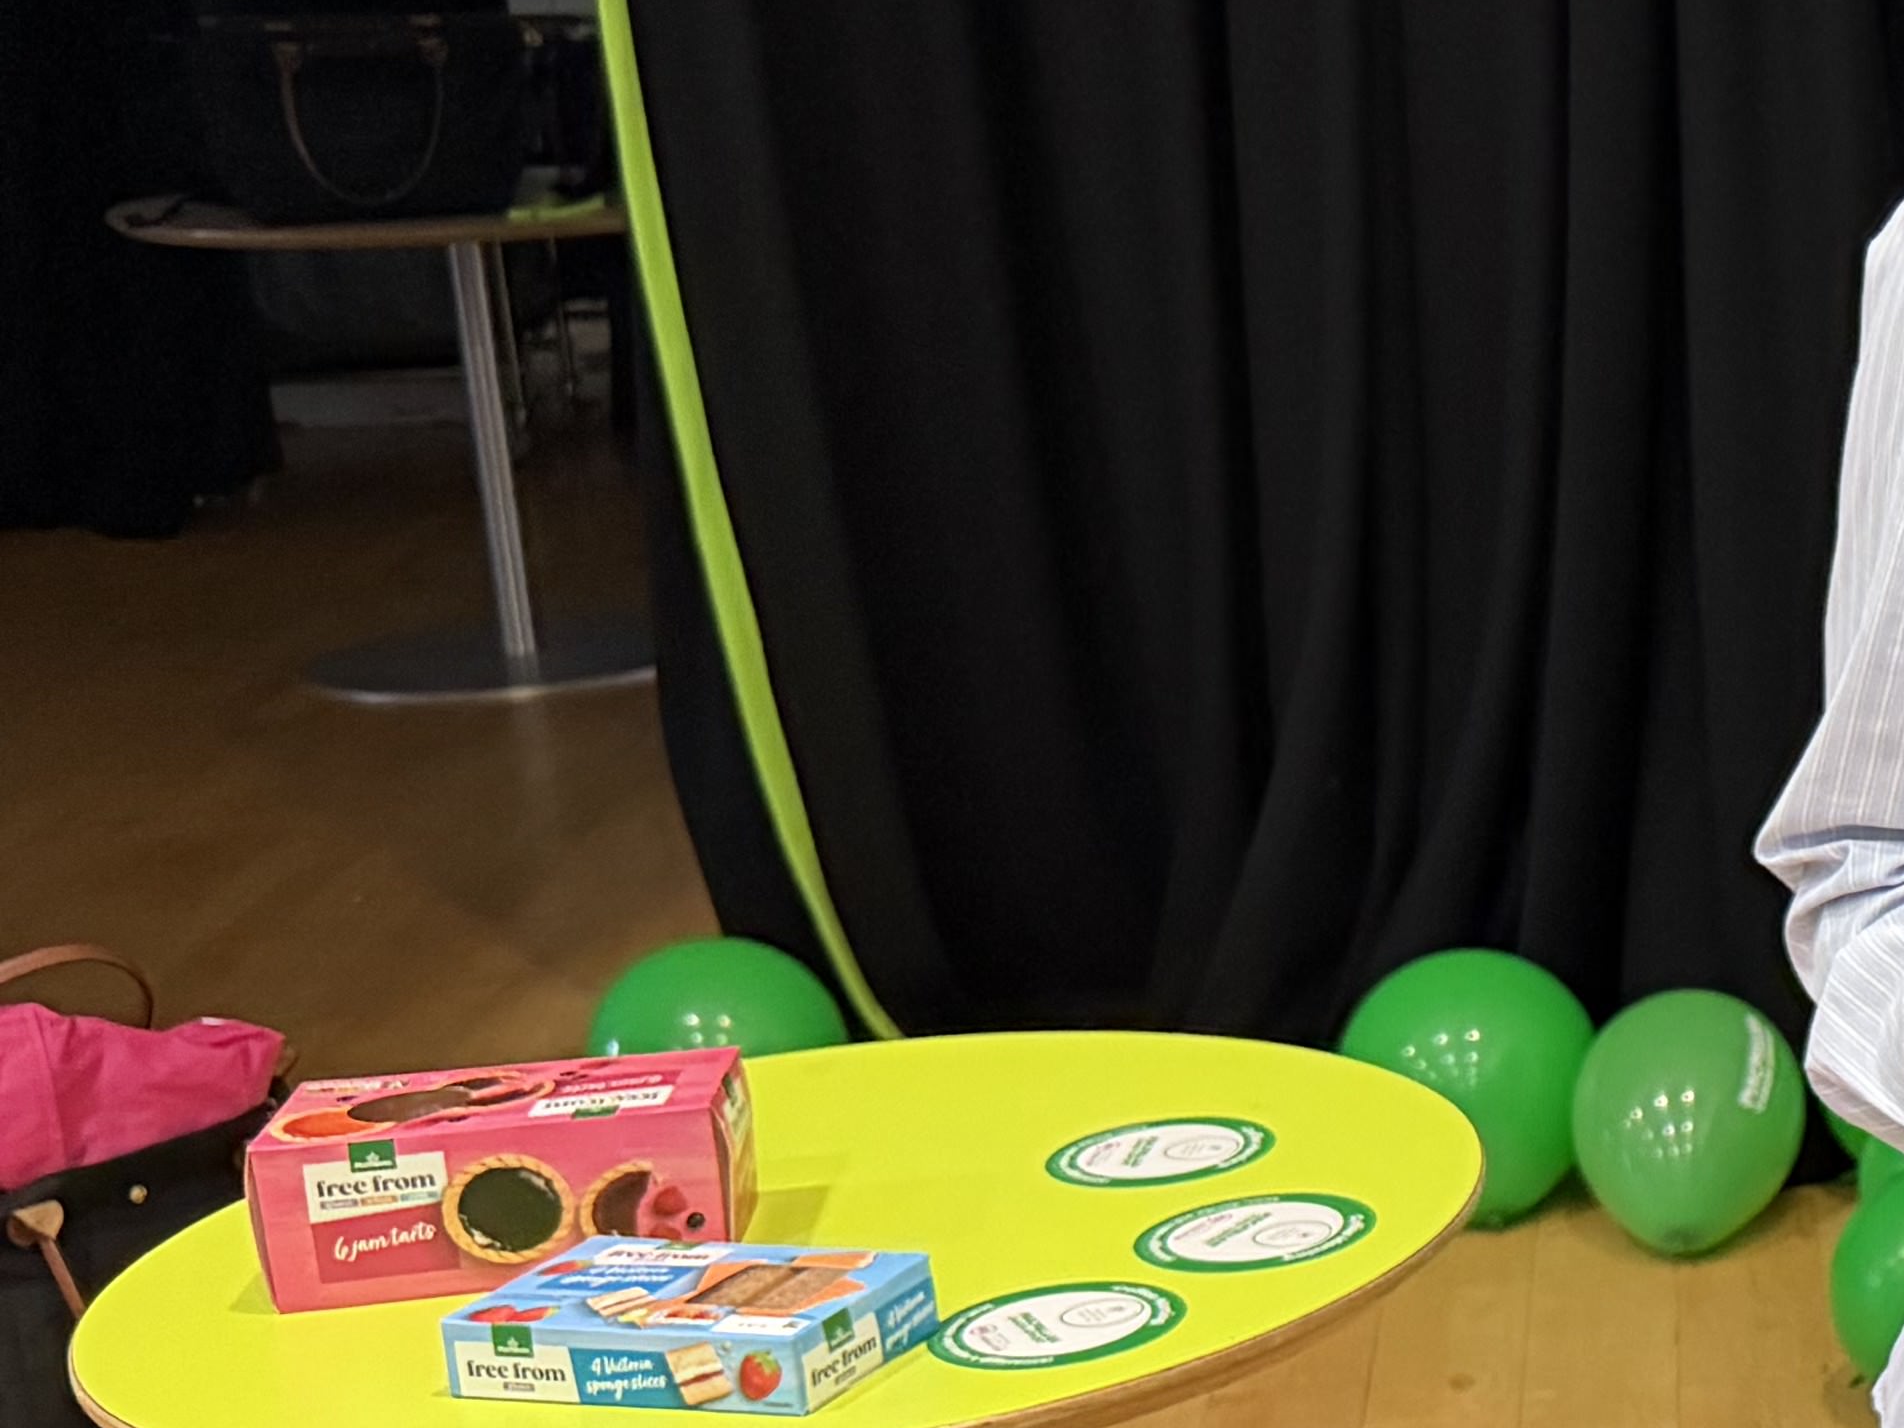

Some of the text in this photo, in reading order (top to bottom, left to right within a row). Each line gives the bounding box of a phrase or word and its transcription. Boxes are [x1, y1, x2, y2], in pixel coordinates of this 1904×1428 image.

[316, 1173, 437, 1199] free from
[347, 1235, 390, 1262] jam
[391, 1221, 437, 1245] tarts
[466, 1360, 567, 1382] free from
[811, 1358, 840, 1387] free
[841, 1336, 878, 1367] from
